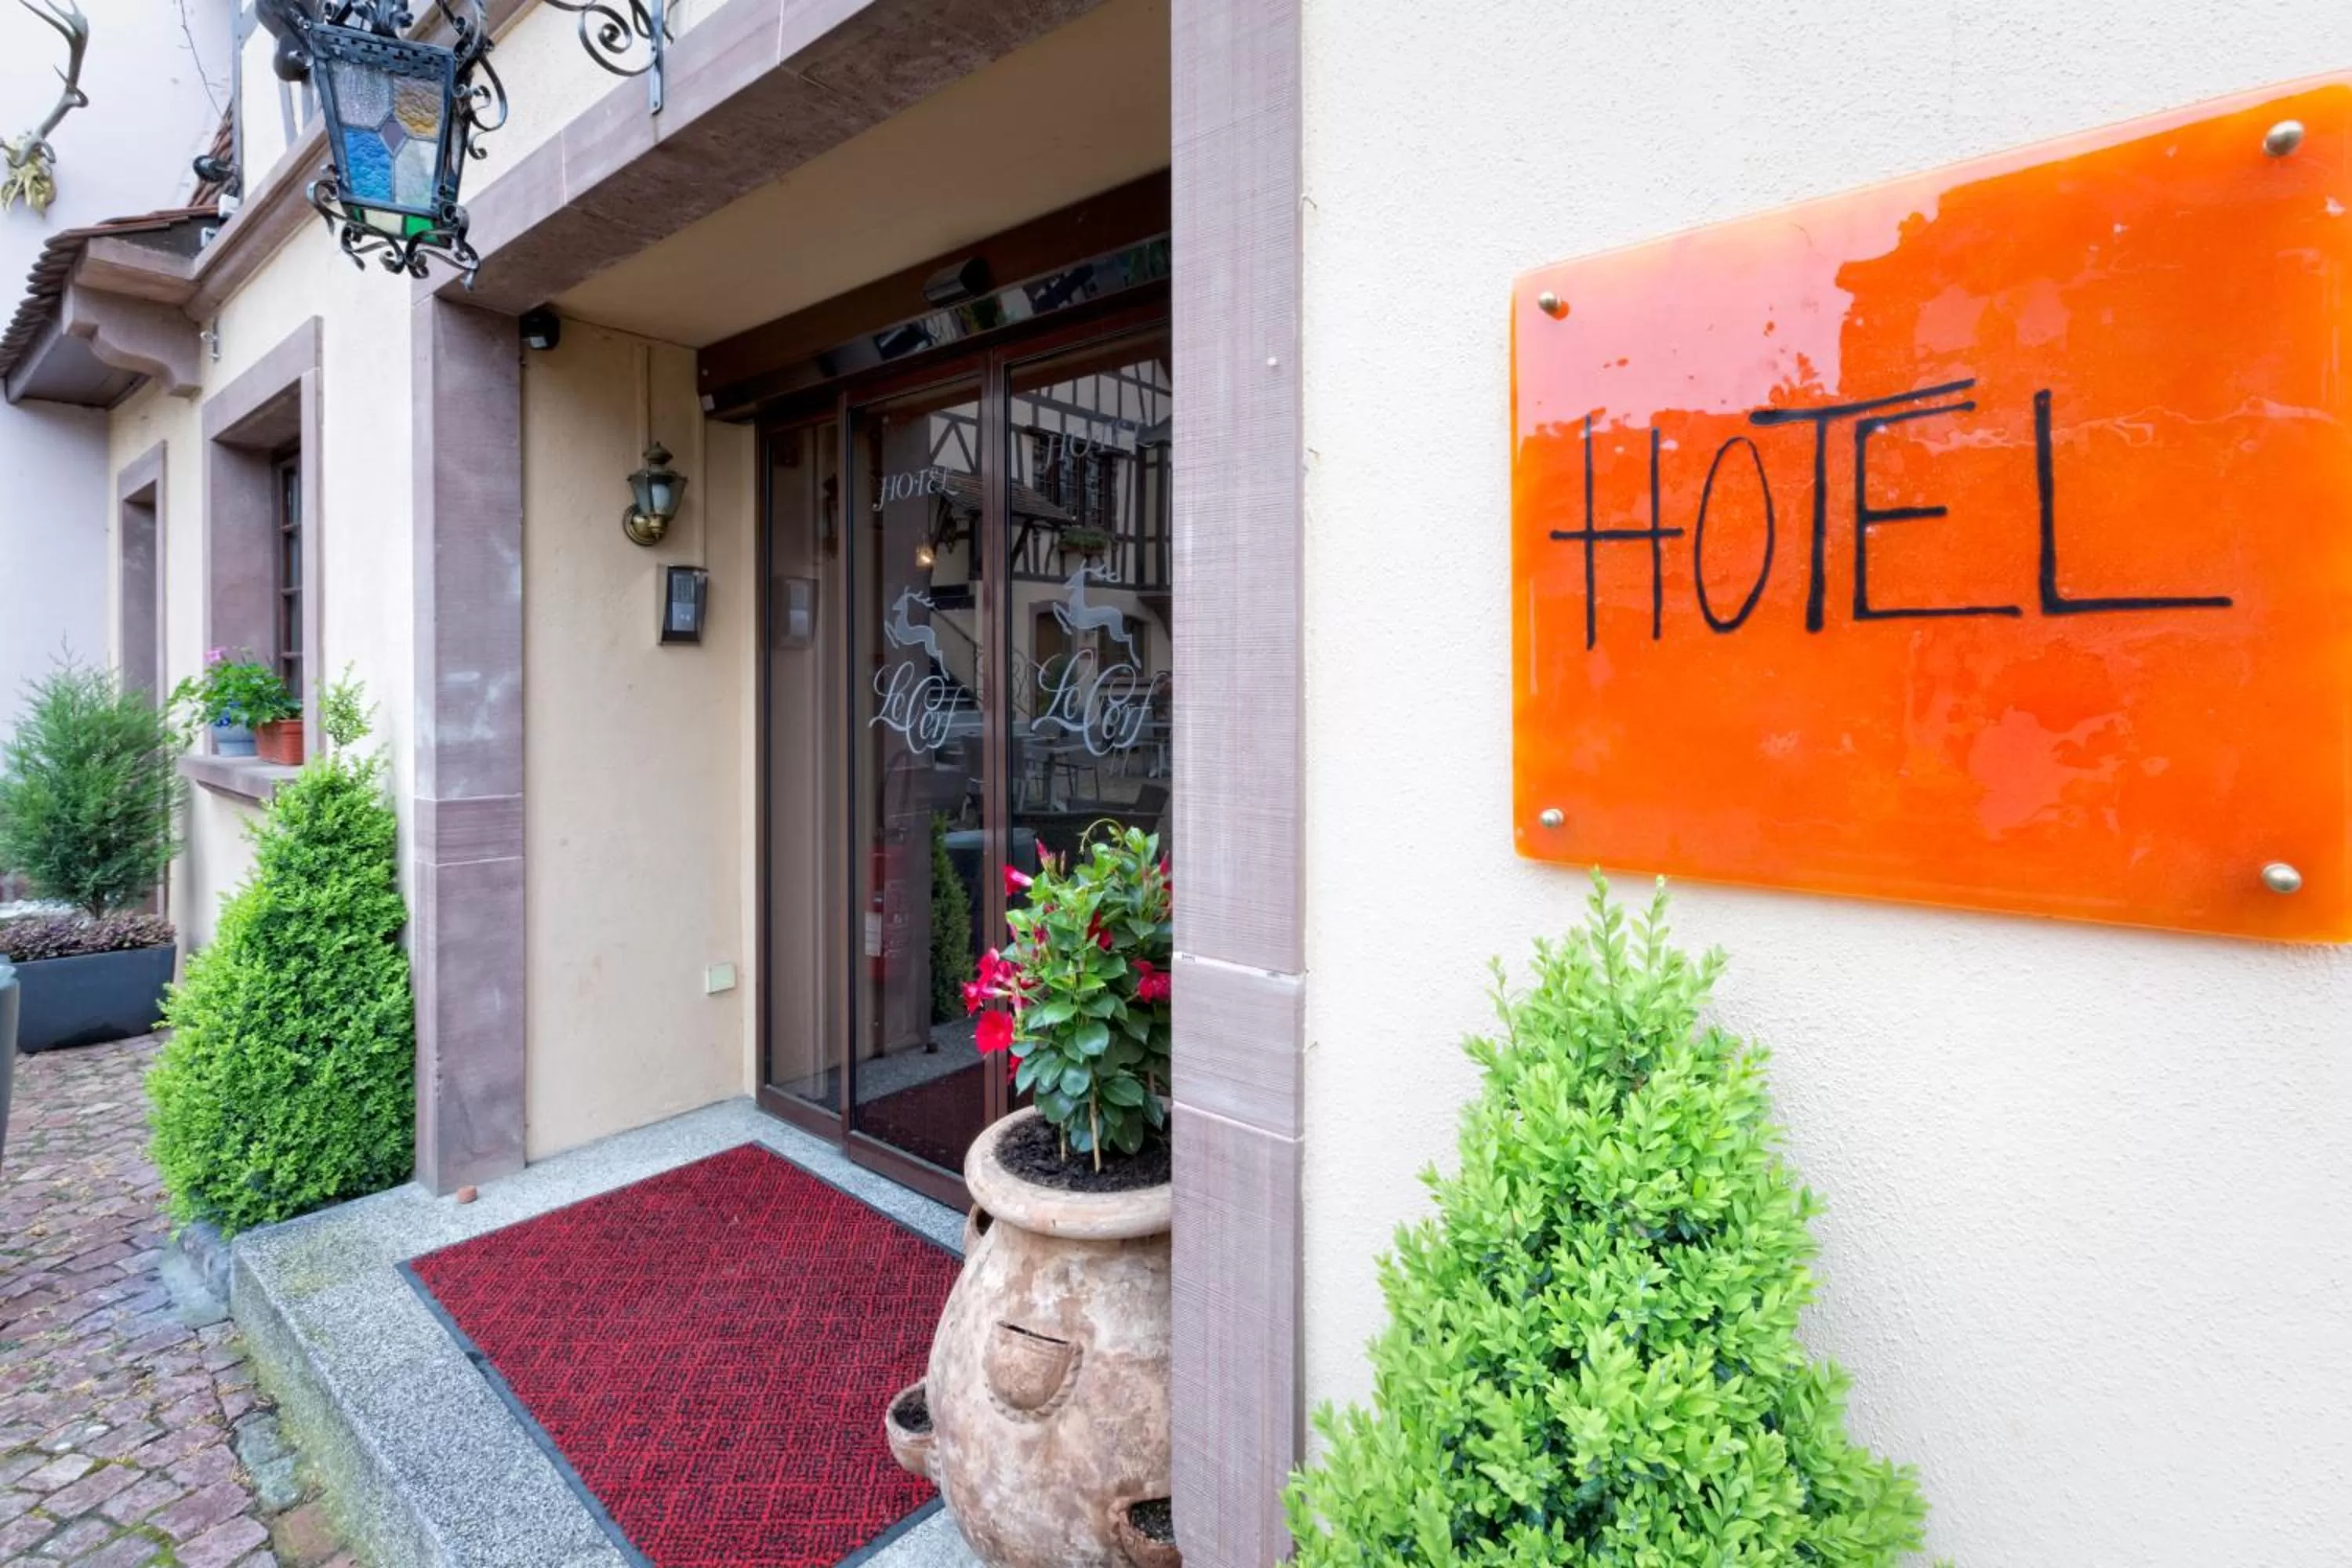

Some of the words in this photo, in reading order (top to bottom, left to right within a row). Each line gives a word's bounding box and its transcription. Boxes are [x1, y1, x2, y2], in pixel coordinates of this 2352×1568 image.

[872, 466, 959, 512] HOTEL
[1549, 378, 2234, 652] HOTEL
[867, 661, 922, 731] Le
[906, 675, 970, 754] Cerf
[1031, 648, 1103, 731] Le
[1083, 663, 1168, 757] Cerf
